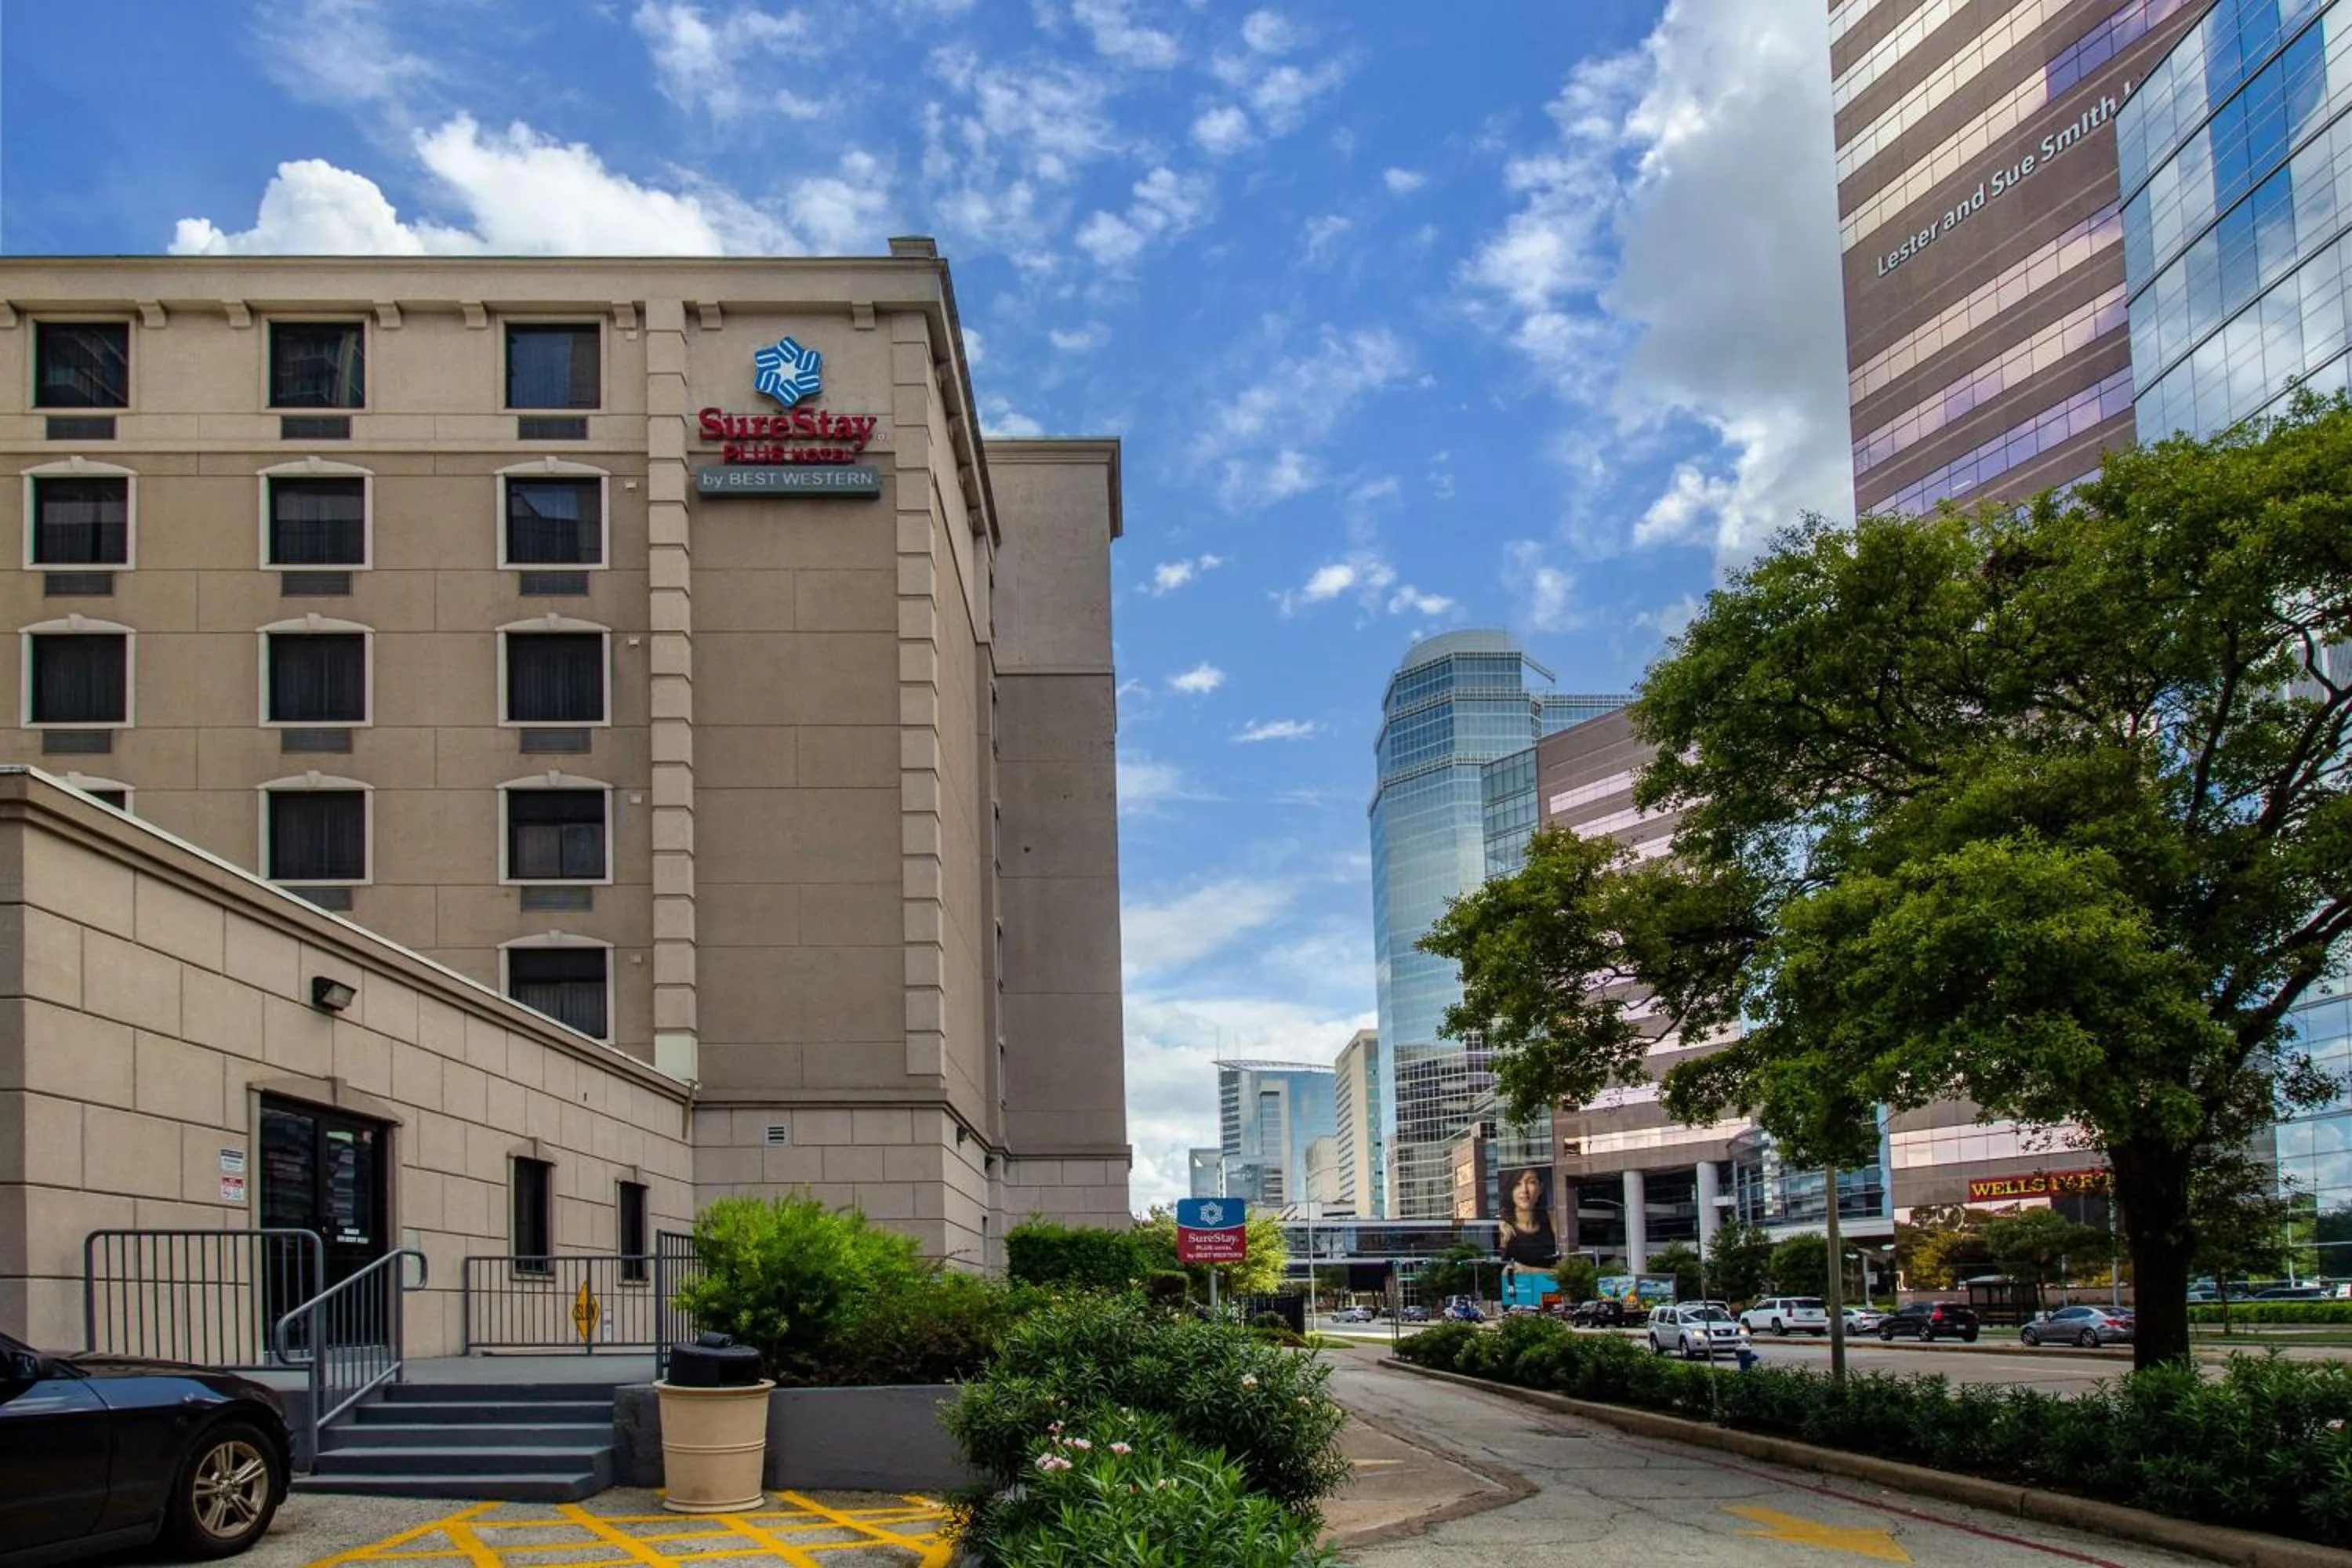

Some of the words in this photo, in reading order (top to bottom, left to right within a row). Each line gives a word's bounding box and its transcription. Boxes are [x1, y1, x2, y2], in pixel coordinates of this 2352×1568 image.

[1877, 220, 1940, 278] Lester
[1943, 183, 1986, 230] and
[1990, 153, 2036, 198] Sue
[2040, 96, 2117, 162] Smith
[699, 406, 877, 452] SureStay
[722, 445, 785, 464] PLUS
[703, 472, 724, 488] by
[729, 472, 777, 485] BEST
[782, 472, 873, 486] WESTERN
[1971, 1178, 2045, 1197] WELLS
[2050, 1173, 2114, 1191] FAR
[1188, 1232, 1238, 1246] SureStay
